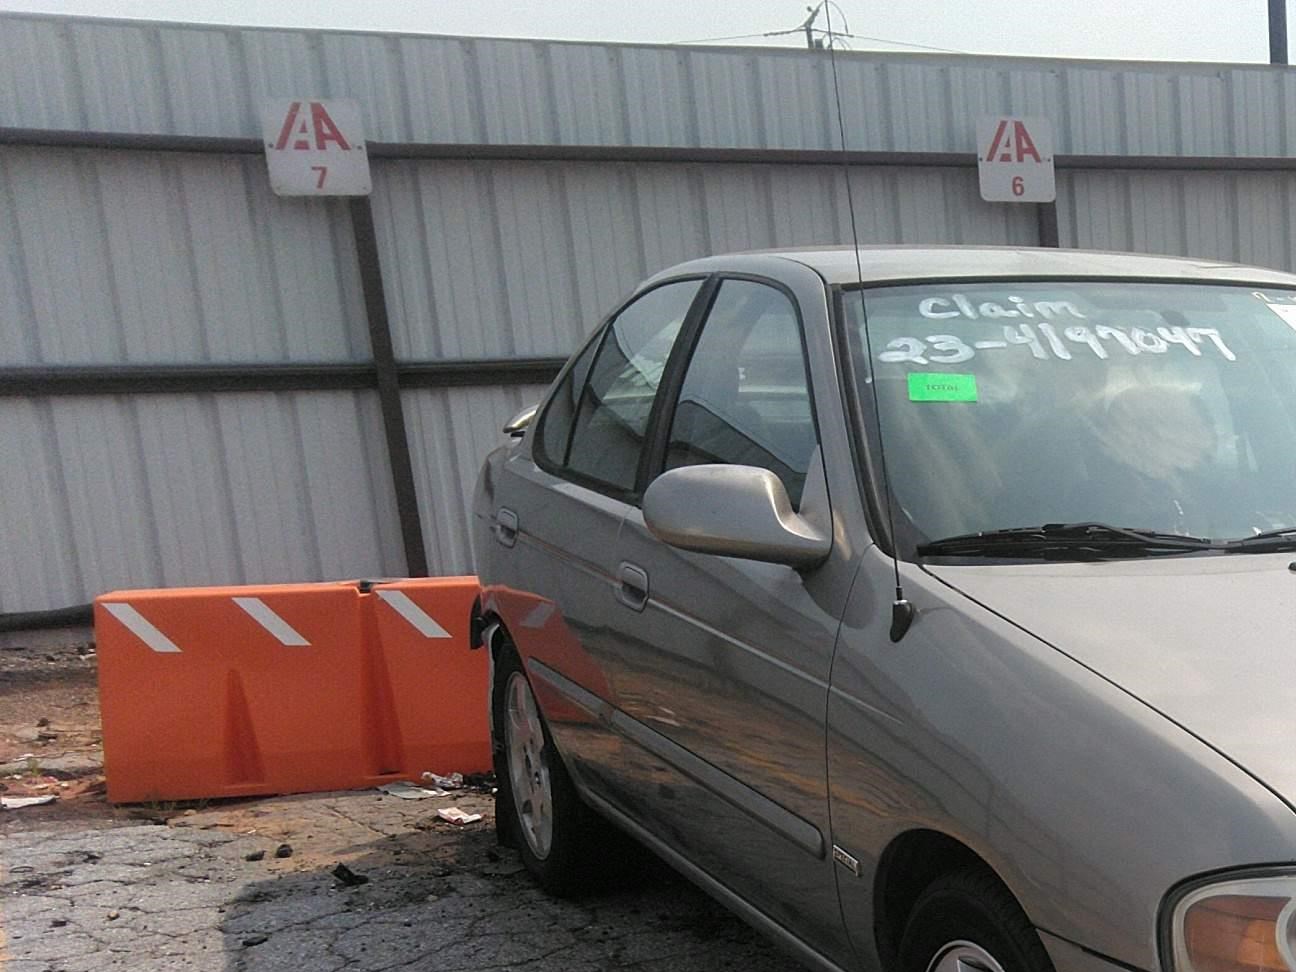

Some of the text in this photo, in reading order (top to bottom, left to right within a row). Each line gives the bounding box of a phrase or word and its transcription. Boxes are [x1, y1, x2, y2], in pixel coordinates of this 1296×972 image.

[311, 166, 328, 189] 7
[1012, 176, 1025, 197] 6
[918, 294, 1087, 320] Claim
